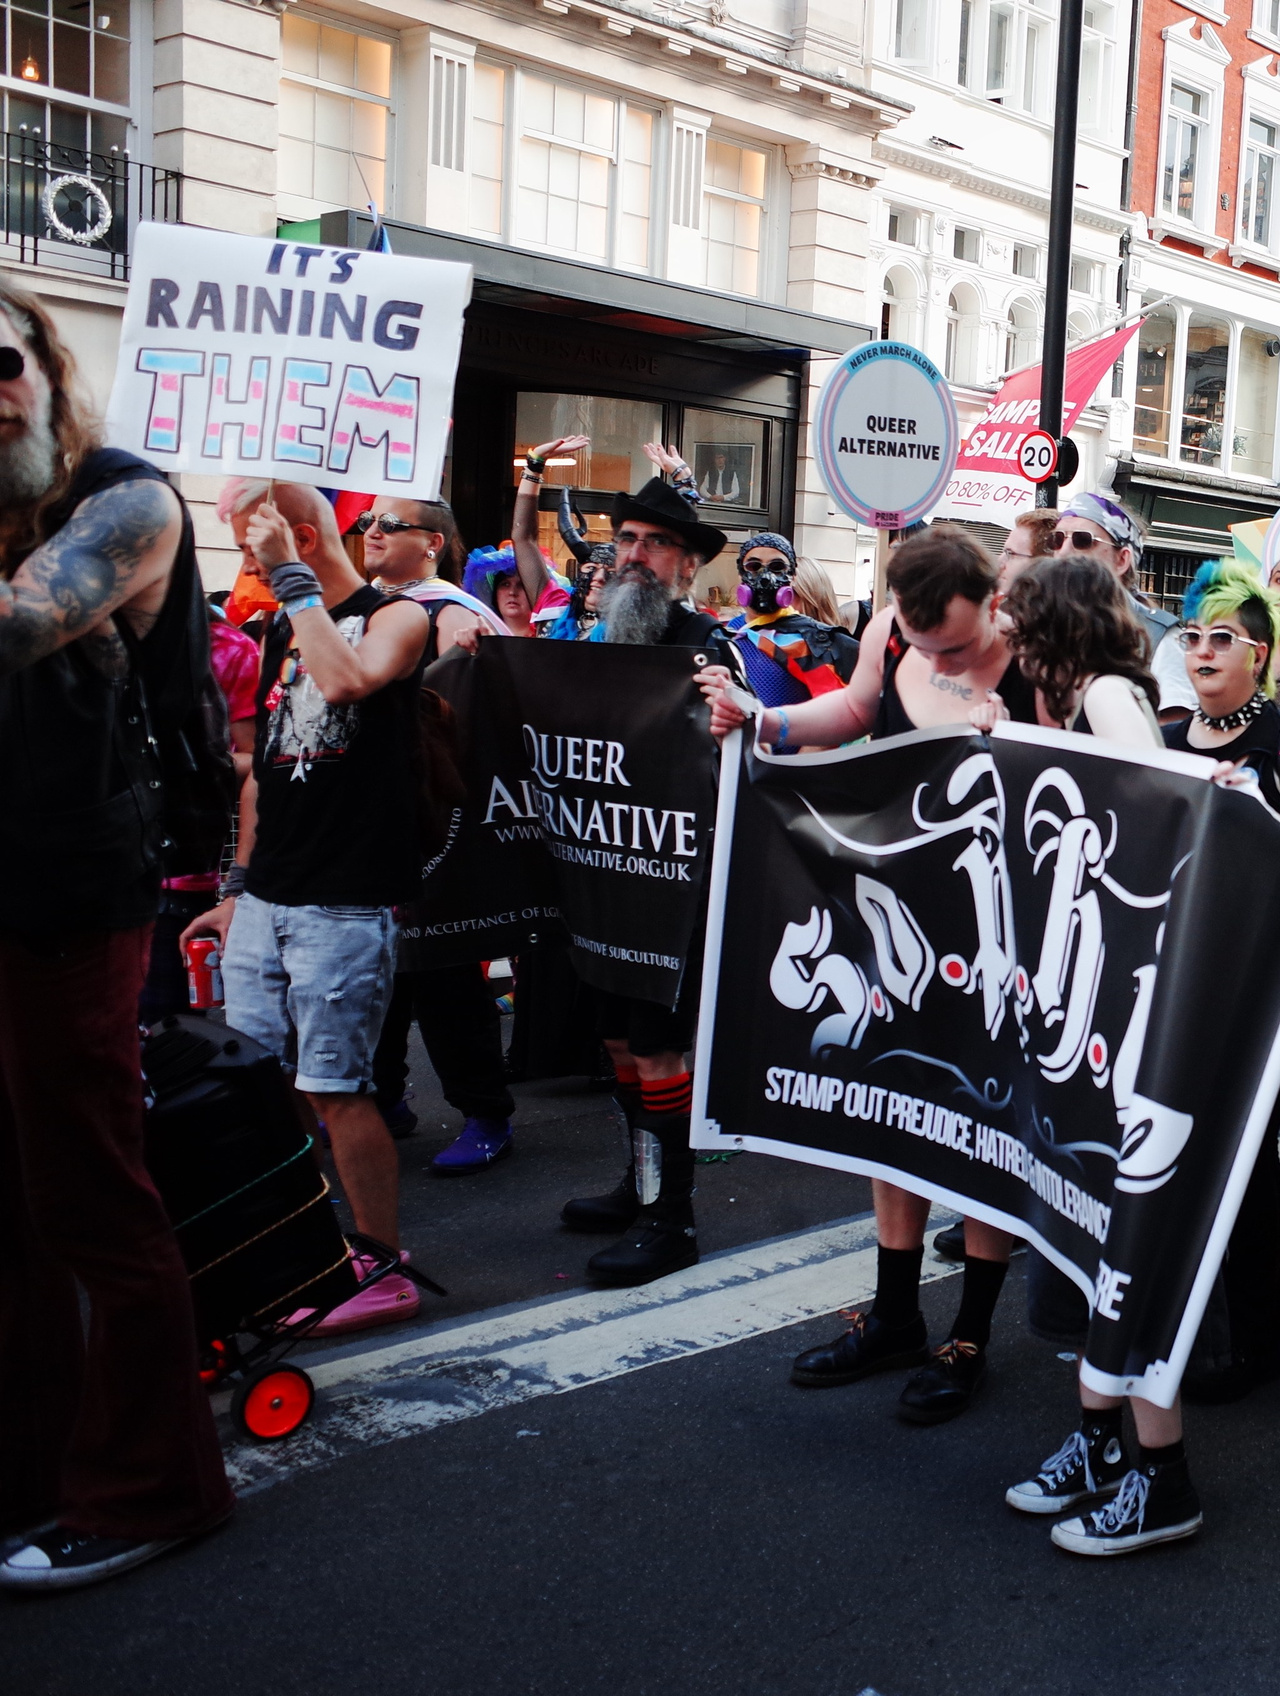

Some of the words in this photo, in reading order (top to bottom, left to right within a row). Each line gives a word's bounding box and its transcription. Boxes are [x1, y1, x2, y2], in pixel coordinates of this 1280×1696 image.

[265, 243, 361, 284] IT'S
[145, 278, 424, 351] RAINING
[849, 347, 879, 370] NEVER
[880, 345, 912, 359] MARCH
[912, 353, 938, 380] ALONE
[135, 347, 420, 482] THEM
[866, 414, 917, 436] QUEER
[980, 399, 1077, 427] SAMPE
[838, 436, 941, 462] ALTERNATIVE
[1024, 446, 1051, 467] 20
[958, 481, 994, 500] 80%
[993, 485, 1033, 507] OFF
[875, 511, 899, 521] PRIDE
[522, 723, 632, 788] QUEER
[424, 910, 517, 937] ACCEPTANCE
[521, 906, 541, 920] OF
[608, 945, 680, 971] SUBCULTURES
[764, 1066, 844, 1113] STAMP
[843, 1082, 888, 1123] OUT
[887, 1091, 975, 1161] PREJUDICE,
[975, 1123, 1030, 1184] HATRED
